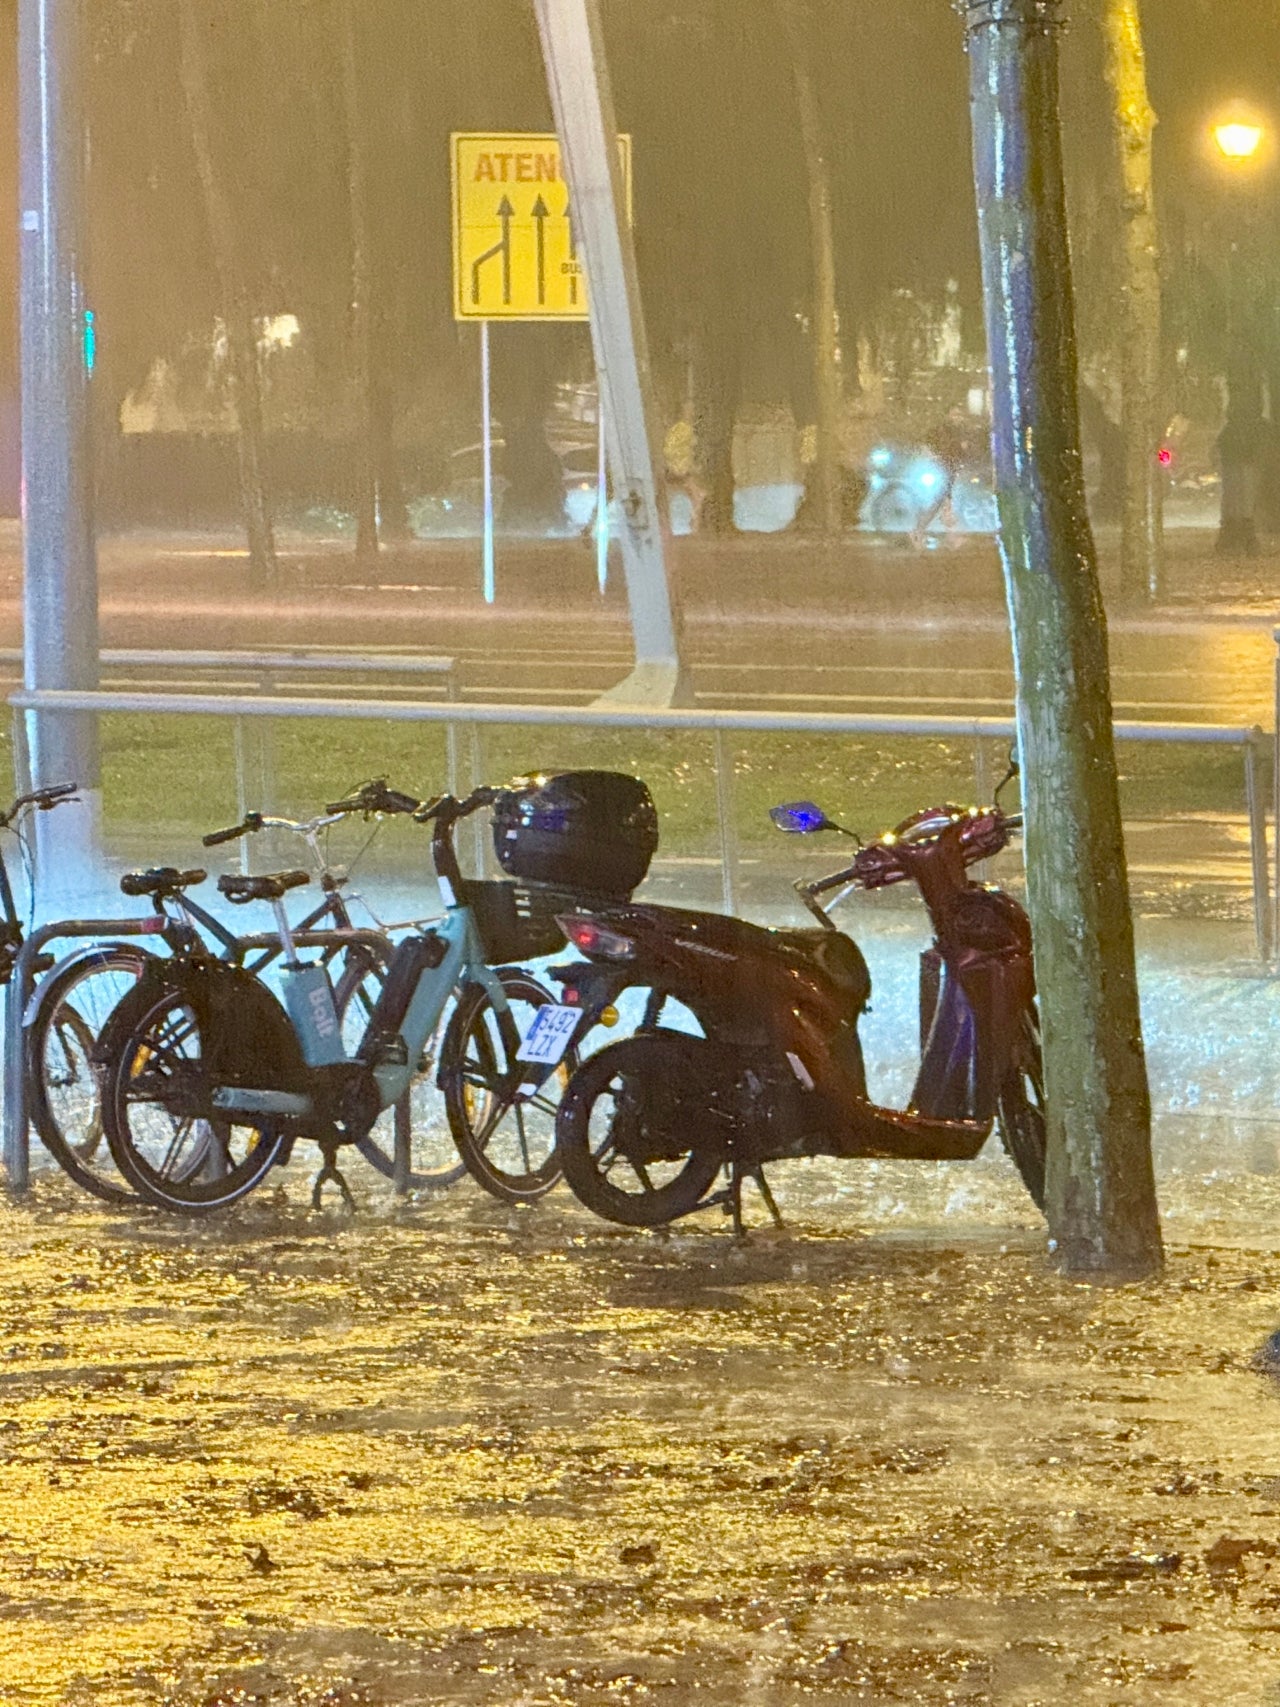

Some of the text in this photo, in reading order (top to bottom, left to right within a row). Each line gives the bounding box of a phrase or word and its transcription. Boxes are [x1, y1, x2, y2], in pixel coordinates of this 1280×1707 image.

[474, 153, 564, 183] ATEN
[308, 987, 334, 1038] Bolt
[539, 1009, 576, 1034] 5492
[527, 1034, 557, 1057] LZX
